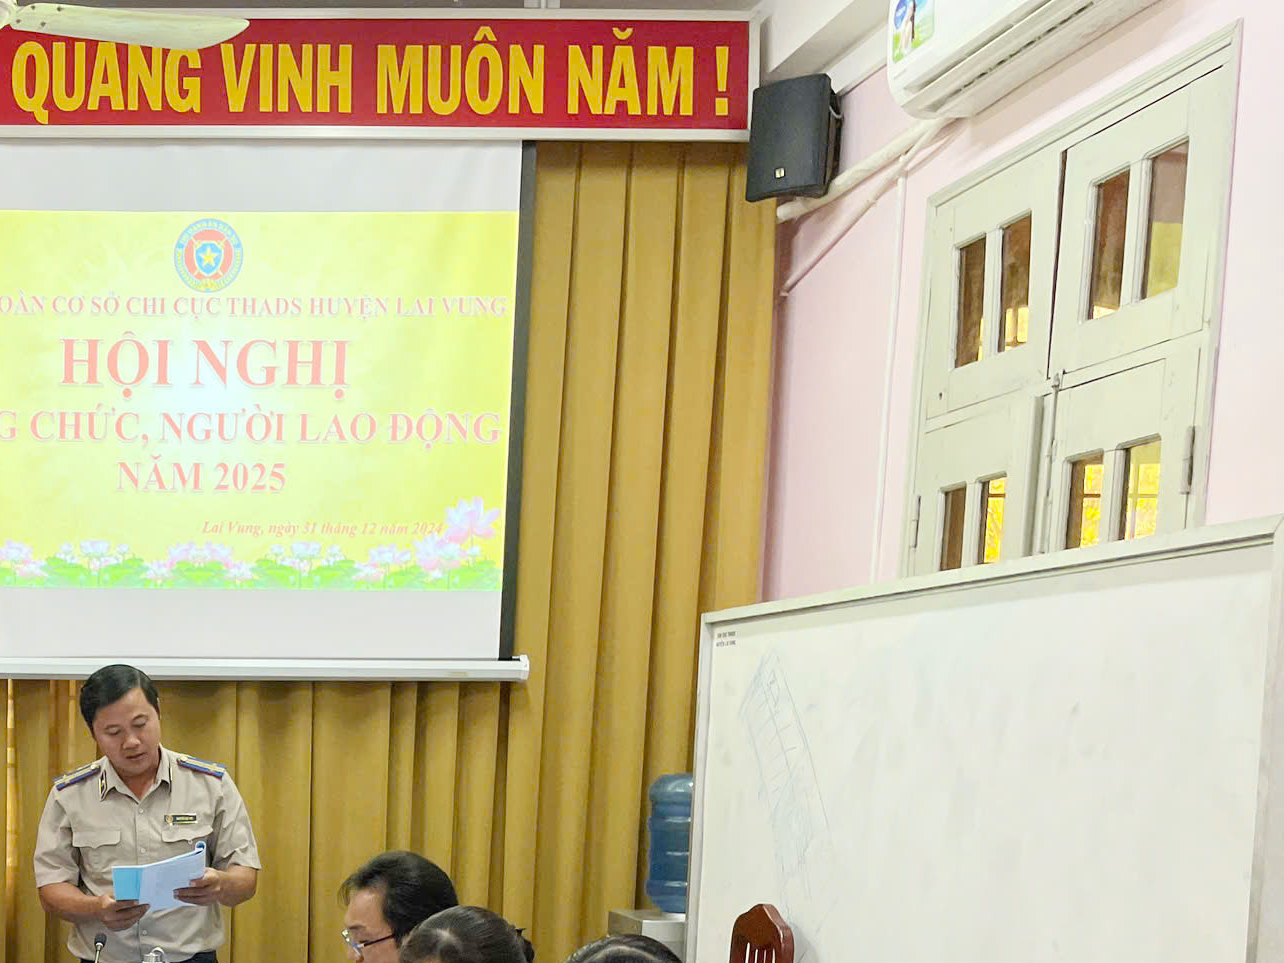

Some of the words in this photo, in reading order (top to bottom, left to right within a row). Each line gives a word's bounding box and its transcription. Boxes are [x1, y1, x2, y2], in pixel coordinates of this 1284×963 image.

[12, 42, 202, 125] QUANG
[221, 44, 352, 114] VINH
[376, 26, 545, 116] MUÔN
[567, 28, 693, 117] NĂM
[715, 46, 728, 117] !
[51, 296, 85, 316] CƠ
[90, 292, 120, 316] SỞ
[126, 297, 165, 316] CHI
[173, 297, 220, 320] CỤC
[228, 297, 302, 317] THADS
[309, 294, 388, 320] HUYỆN
[396, 298, 435, 317] LAI
[441, 297, 507, 317] VUNG
[60, 331, 173, 399] HỘI
[191, 339, 351, 400] NGHỊ
[30, 403, 150, 449] CHỨC,
[160, 404, 285, 443] NGƯỜI
[299, 412, 377, 443] LAO
[388, 407, 502, 450] ĐỘNG
[117, 454, 203, 491] NĂM
[214, 462, 287, 491] 2025
[202, 521, 224, 535] Lai
[227, 522, 265, 538] Vung,
[302, 522, 316, 535] 31
[320, 522, 357, 538] tháng
[361, 522, 377, 536] 12
